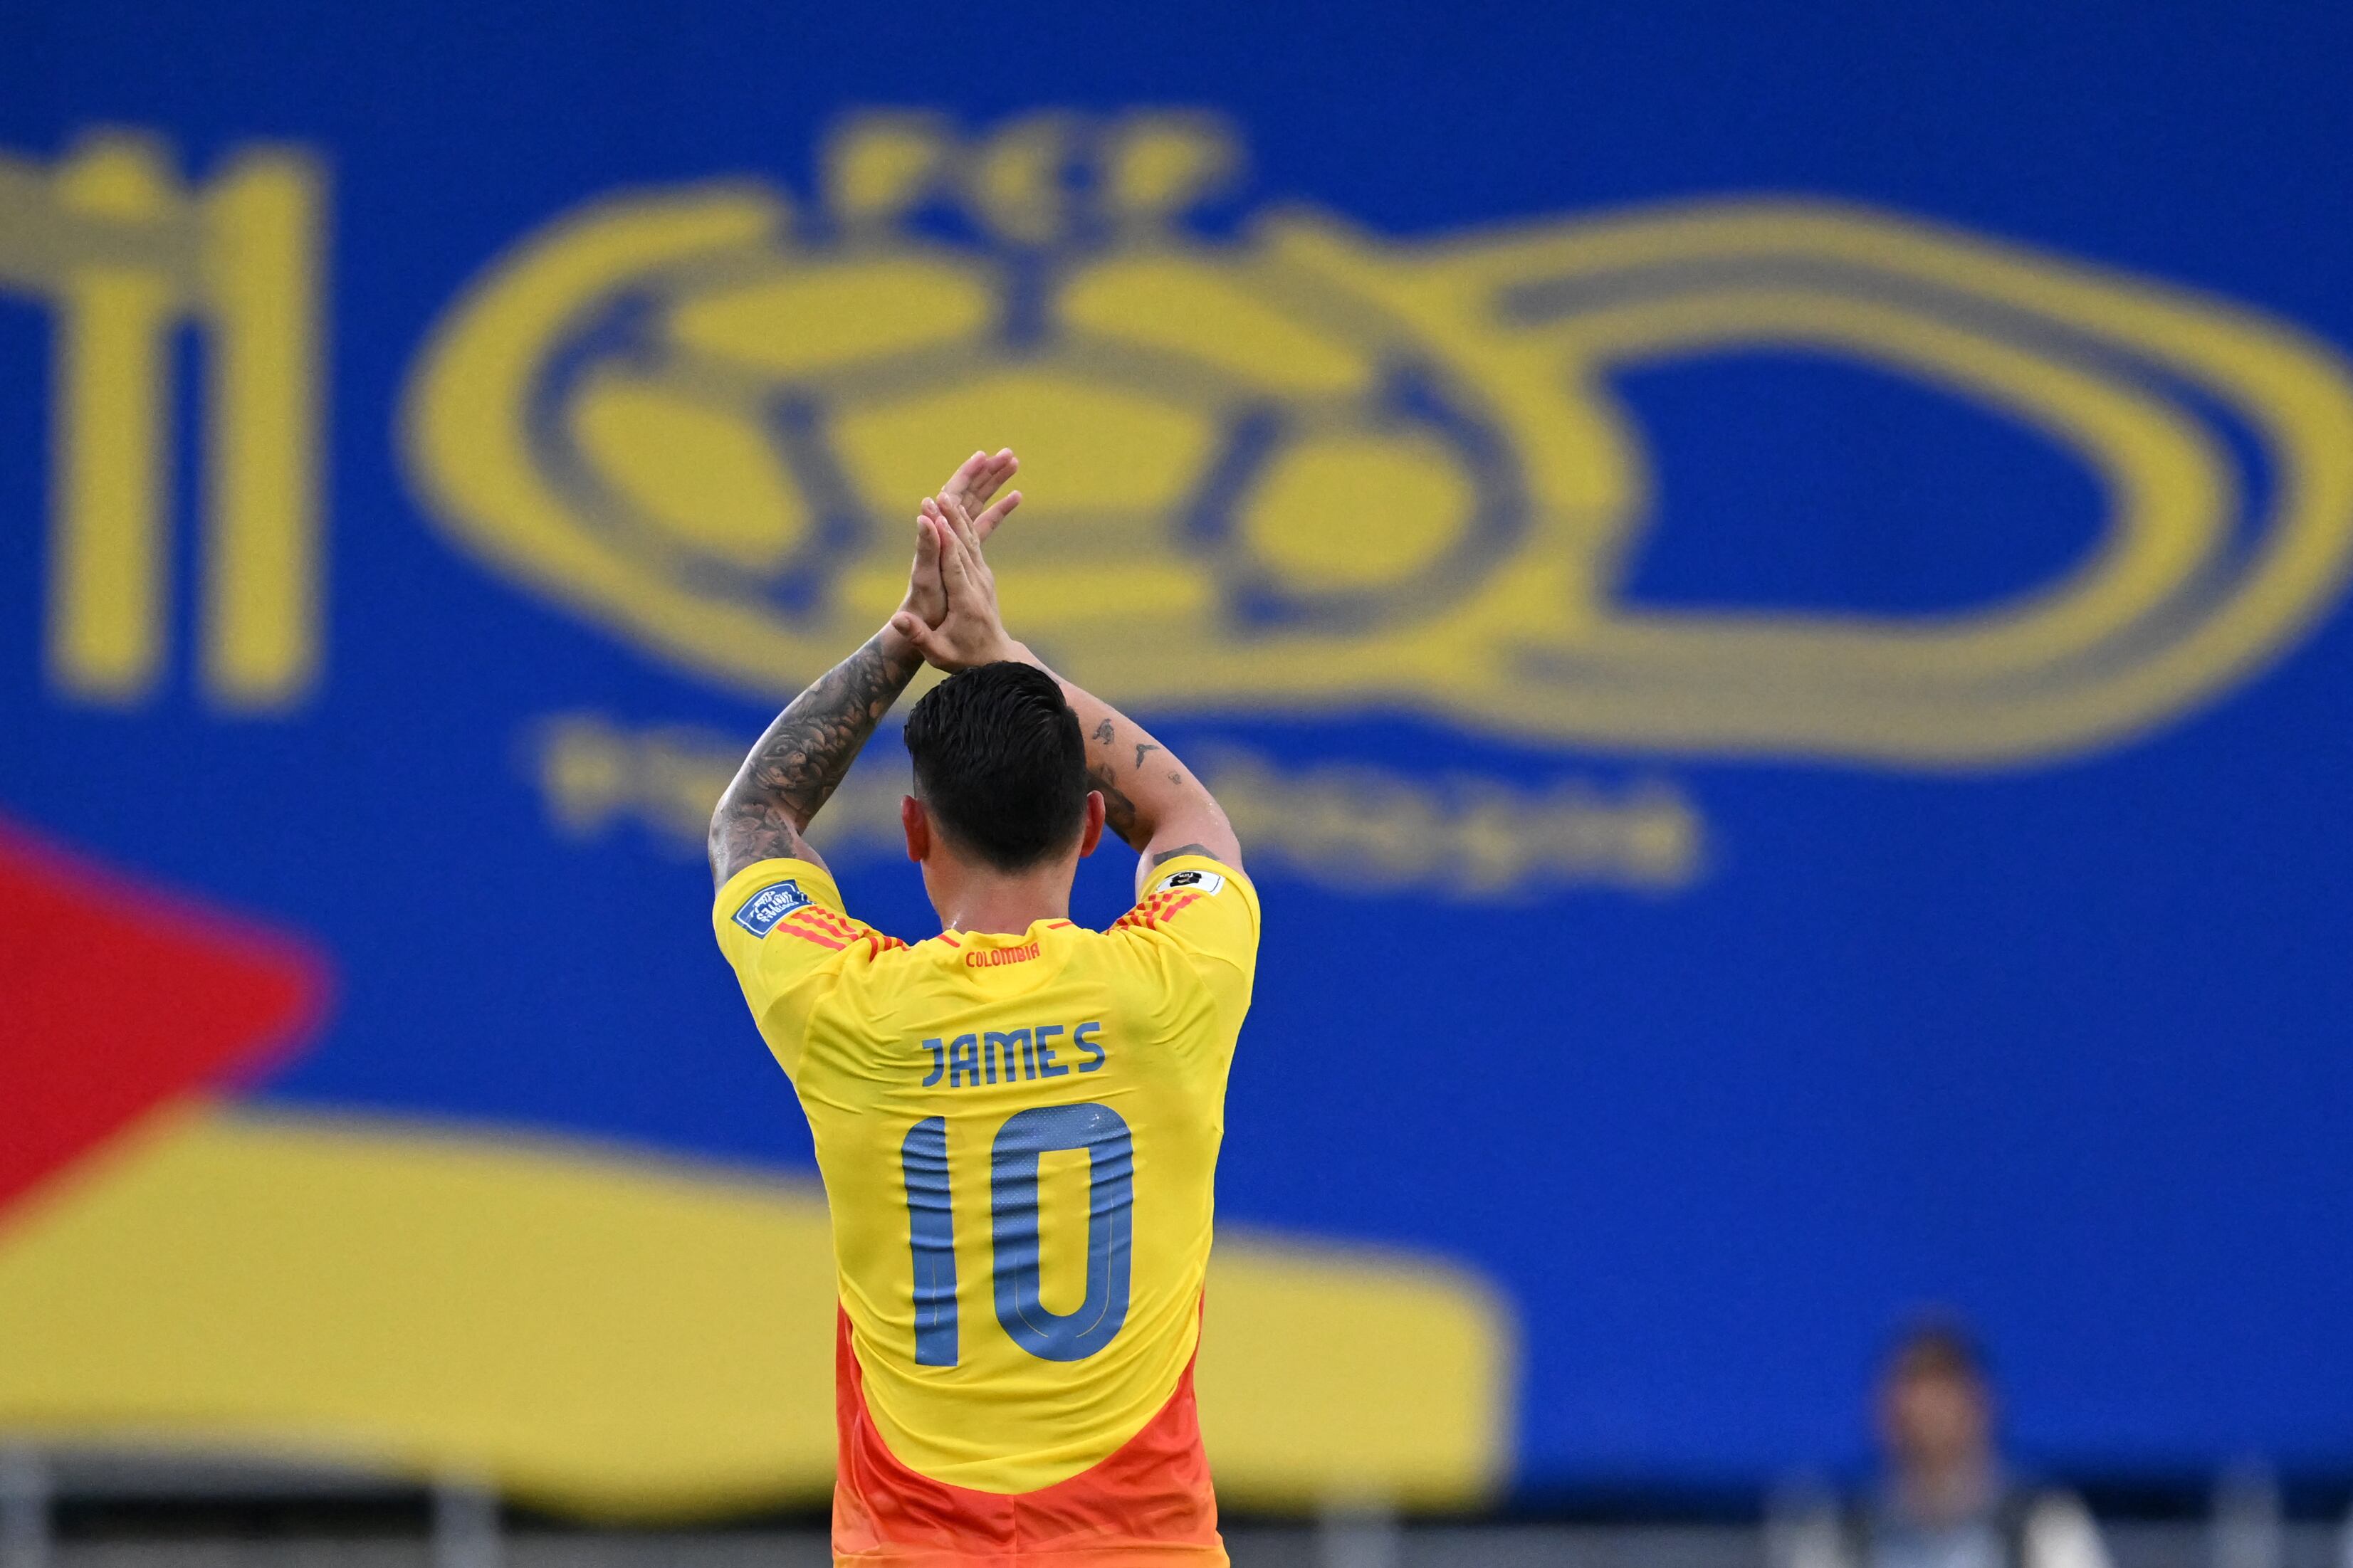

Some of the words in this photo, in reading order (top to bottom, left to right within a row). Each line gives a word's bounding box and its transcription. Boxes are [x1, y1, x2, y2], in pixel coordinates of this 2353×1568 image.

[965, 942, 1040, 968] COLOMBIA
[922, 1022, 1106, 1088] JAMES
[901, 1103, 1133, 1367] 10
